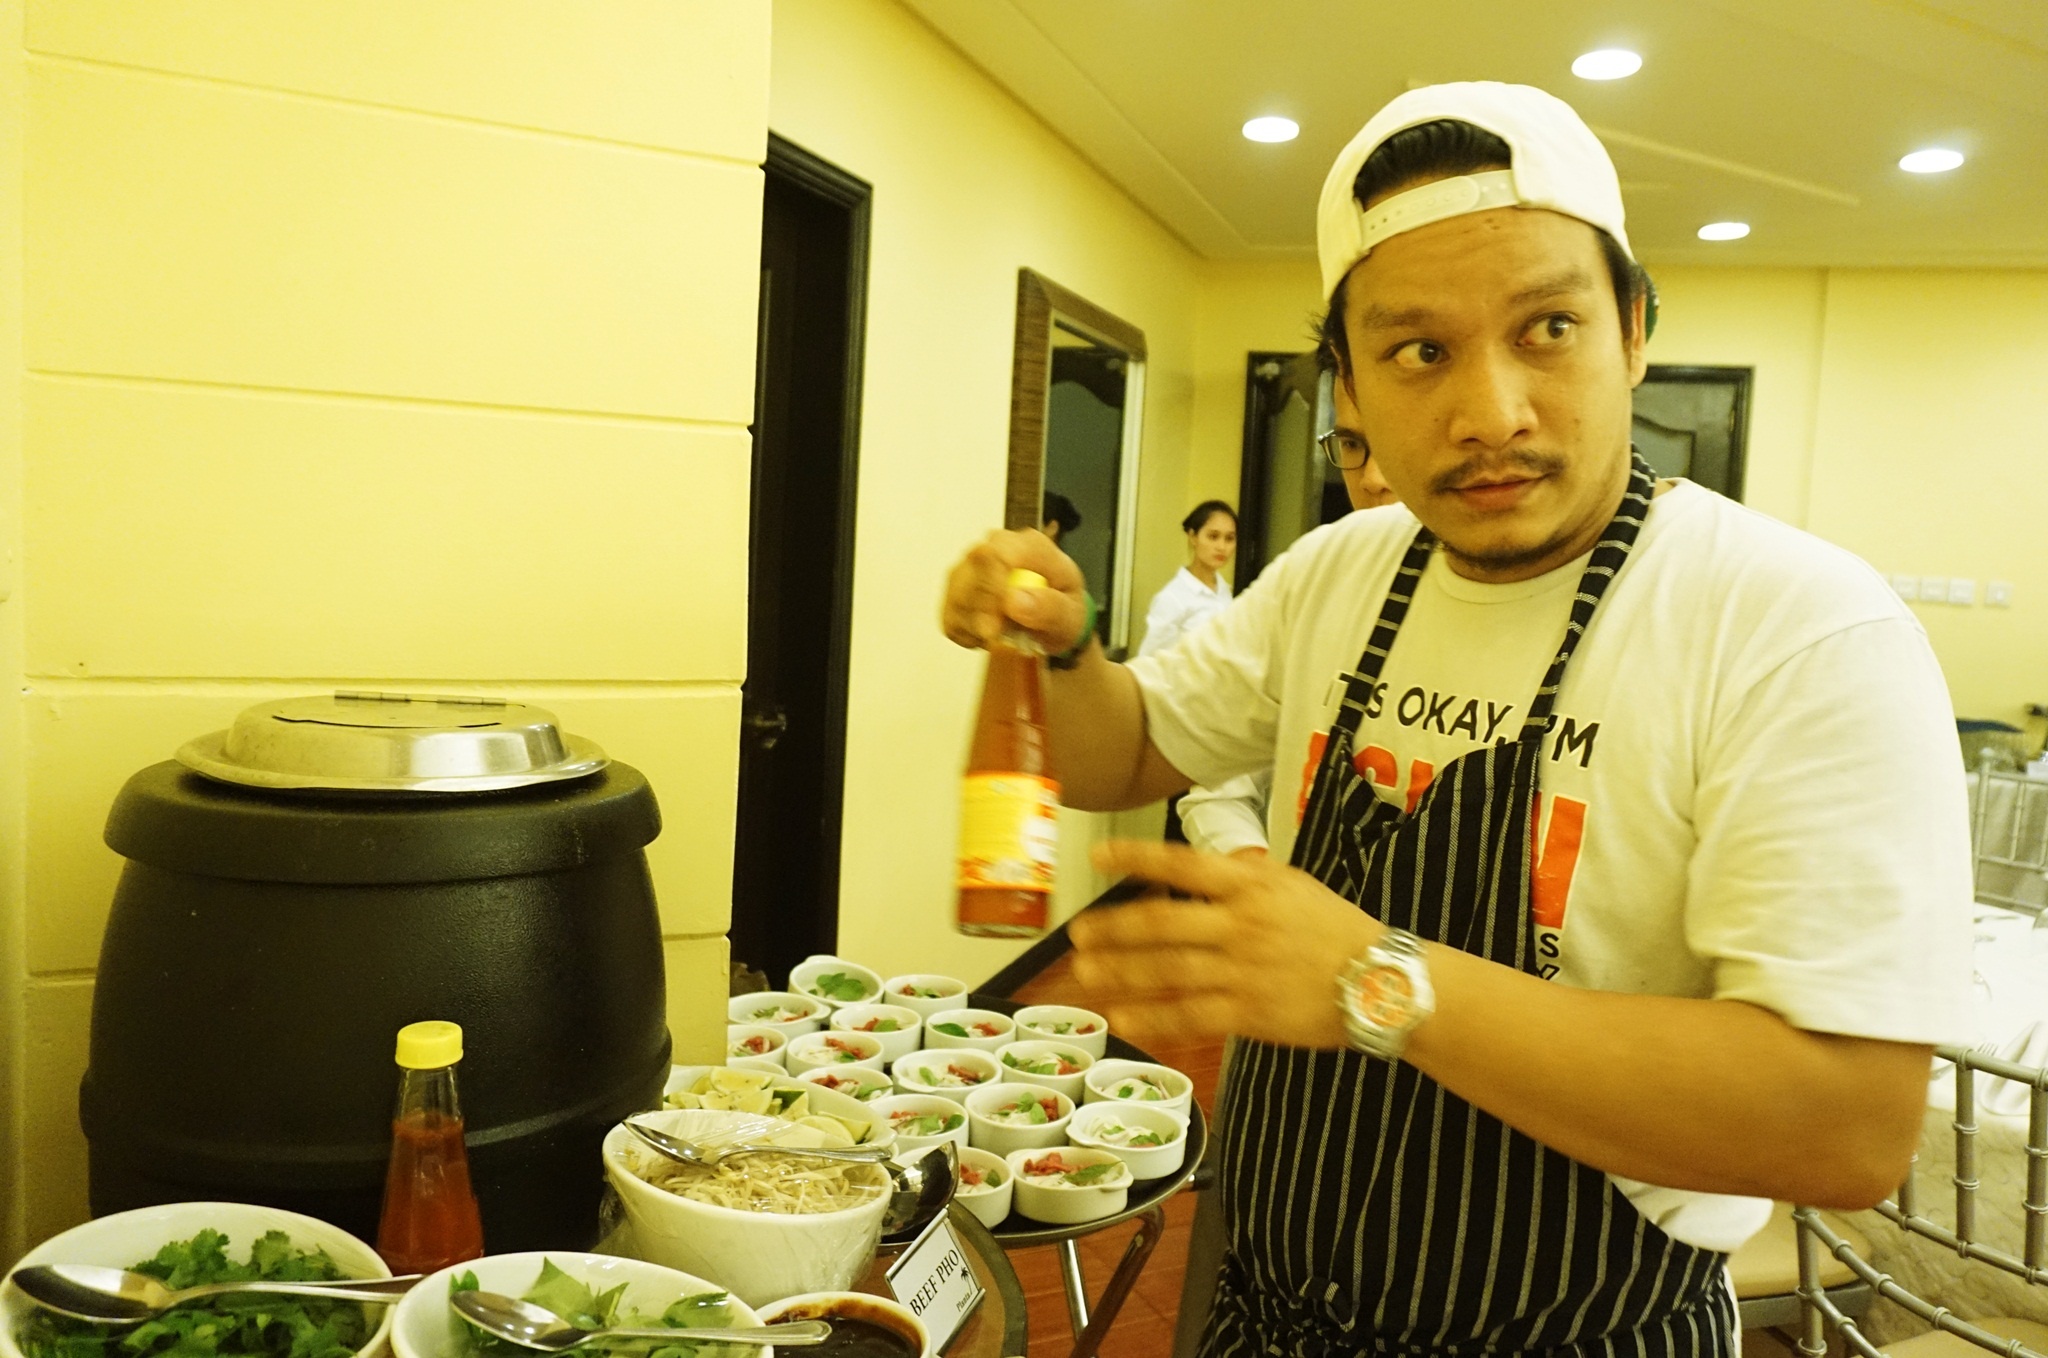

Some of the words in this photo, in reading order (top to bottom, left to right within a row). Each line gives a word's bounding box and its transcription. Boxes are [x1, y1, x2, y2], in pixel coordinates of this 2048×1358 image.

[1543, 713, 1600, 769] 'M
[909, 1274, 939, 1317] BEEF
[935, 1249, 960, 1284] PHO
